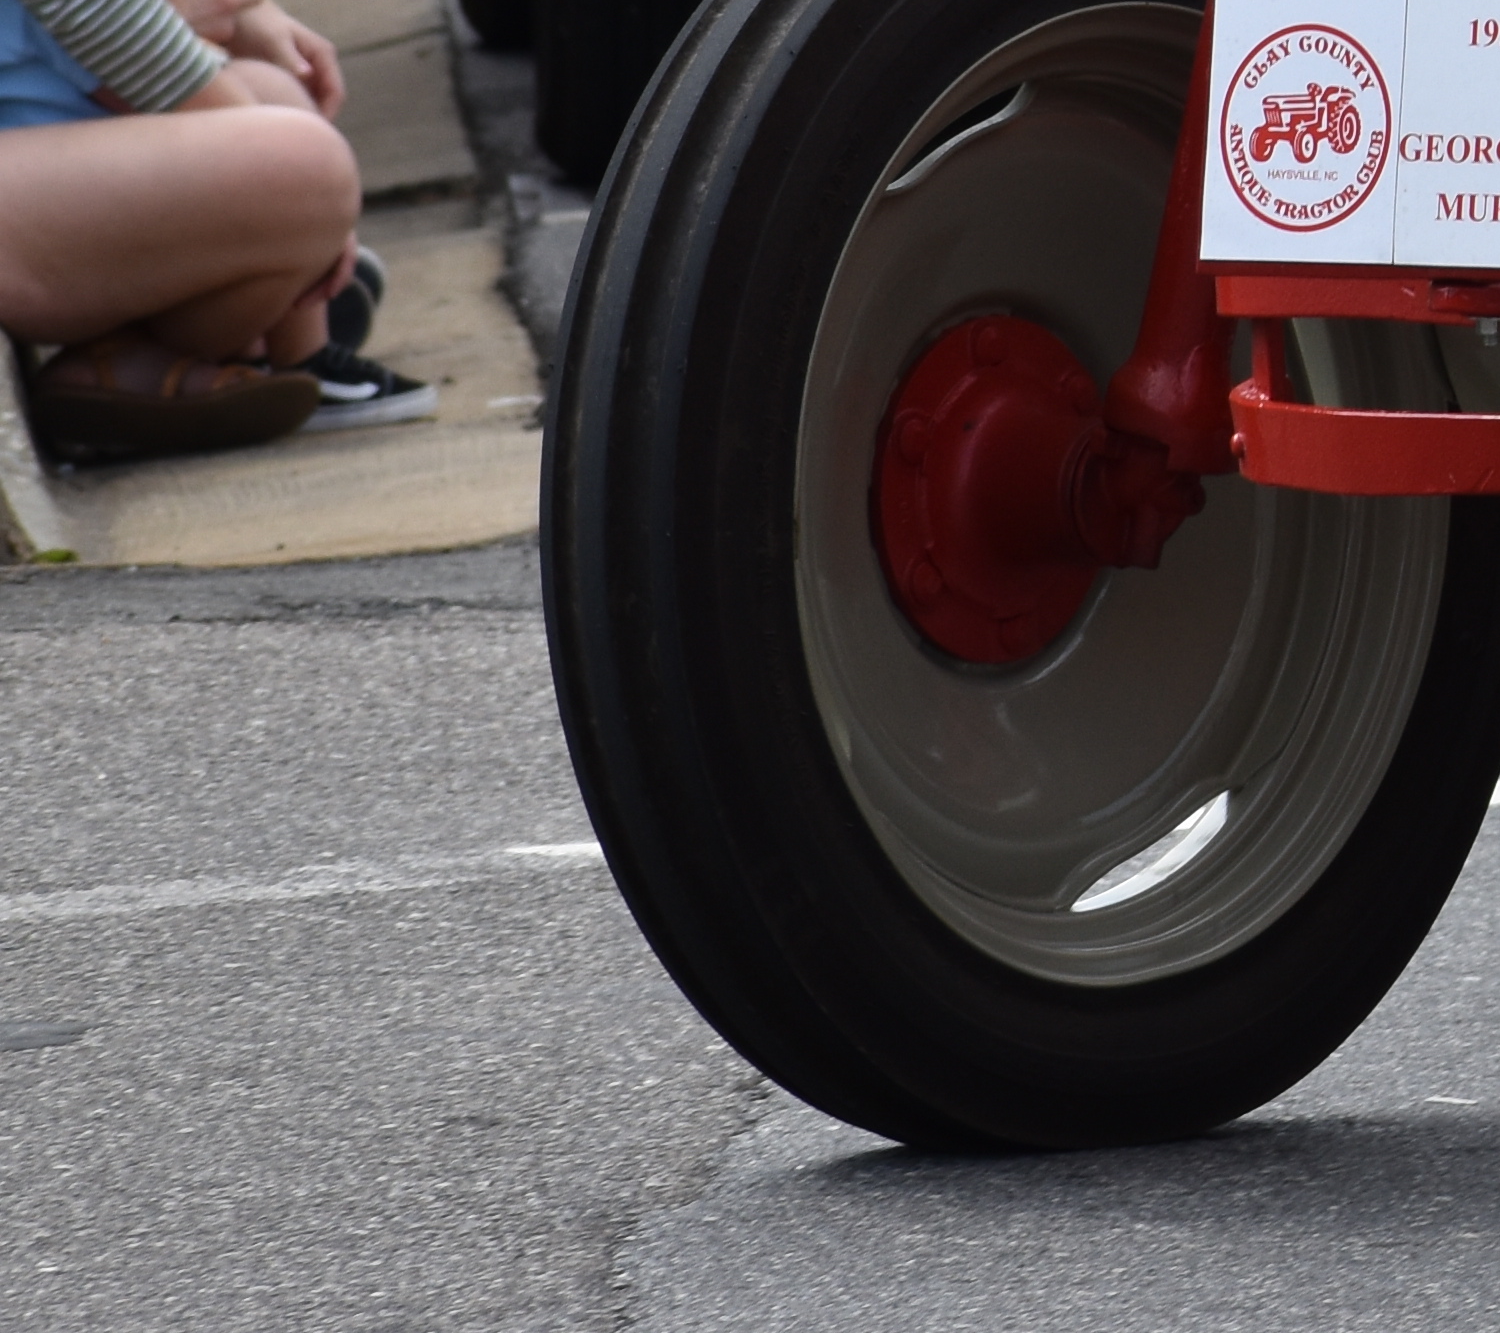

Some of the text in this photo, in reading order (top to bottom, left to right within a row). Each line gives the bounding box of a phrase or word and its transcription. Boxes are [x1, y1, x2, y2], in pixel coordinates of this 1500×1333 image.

[1244, 35, 1375, 92] CLAY COUNTY
[1230, 124, 1384, 221] ANTIQUE TRACTOR CLUB
[1268, 169, 1339, 182] HAYSVILLE, NC
